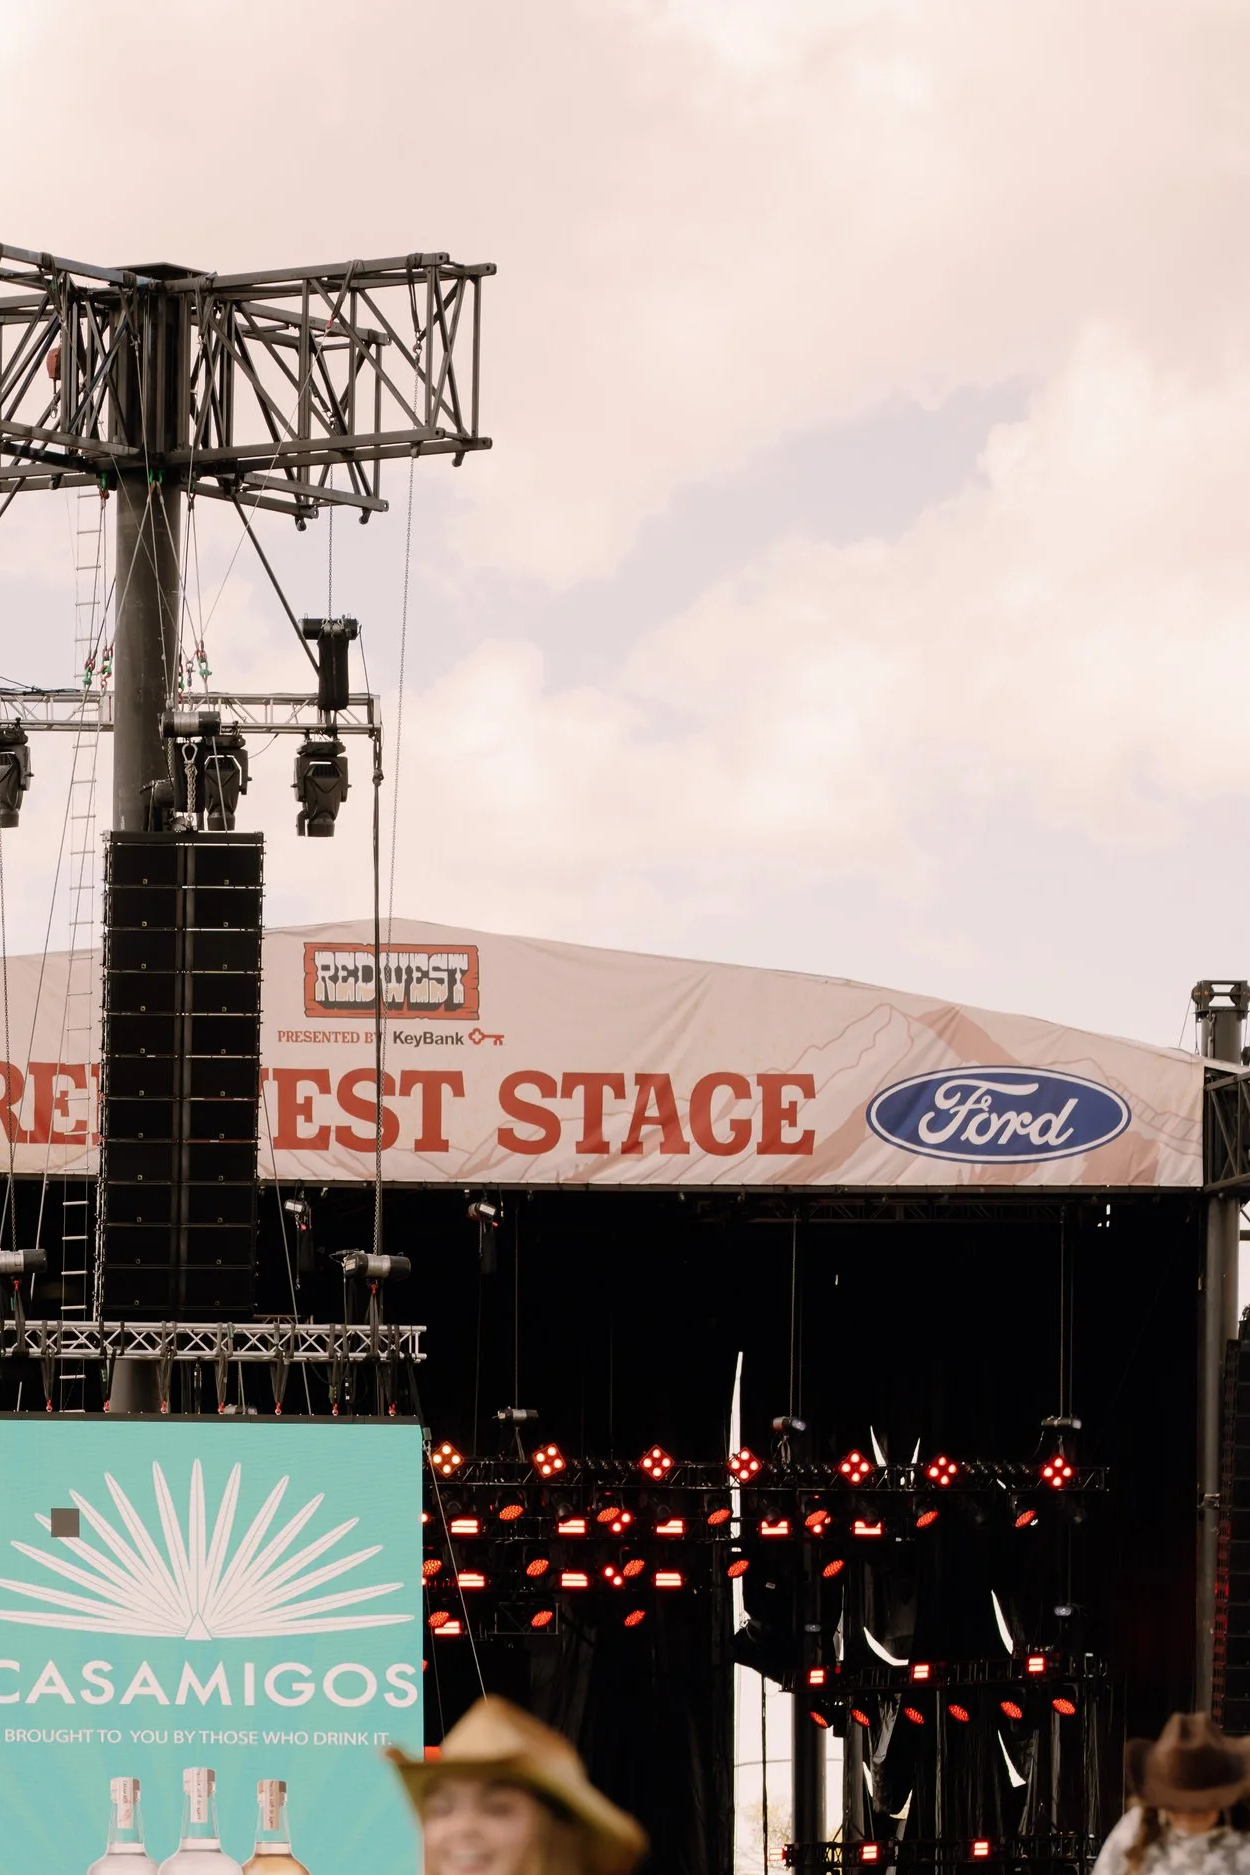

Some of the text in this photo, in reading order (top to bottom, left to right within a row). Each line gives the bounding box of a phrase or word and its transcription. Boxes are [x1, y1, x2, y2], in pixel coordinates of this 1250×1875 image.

[314, 950, 469, 1005] REDWEST
[277, 1030, 361, 1045] PRESENTED
[393, 1030, 465, 1048] KeyBank
[497, 1071, 816, 1156] STAGE
[918, 1078, 1079, 1147] Ford
[4, 1728, 94, 1744] BROUGHT
[96, 1729, 122, 1744] TO
[129, 1729, 169, 1745] YOU
[173, 1730, 196, 1744] BY
[198, 1730, 258, 1746] THOSE
[262, 1730, 309, 1746] WHO
[313, 1731, 369, 1746] DRINK
